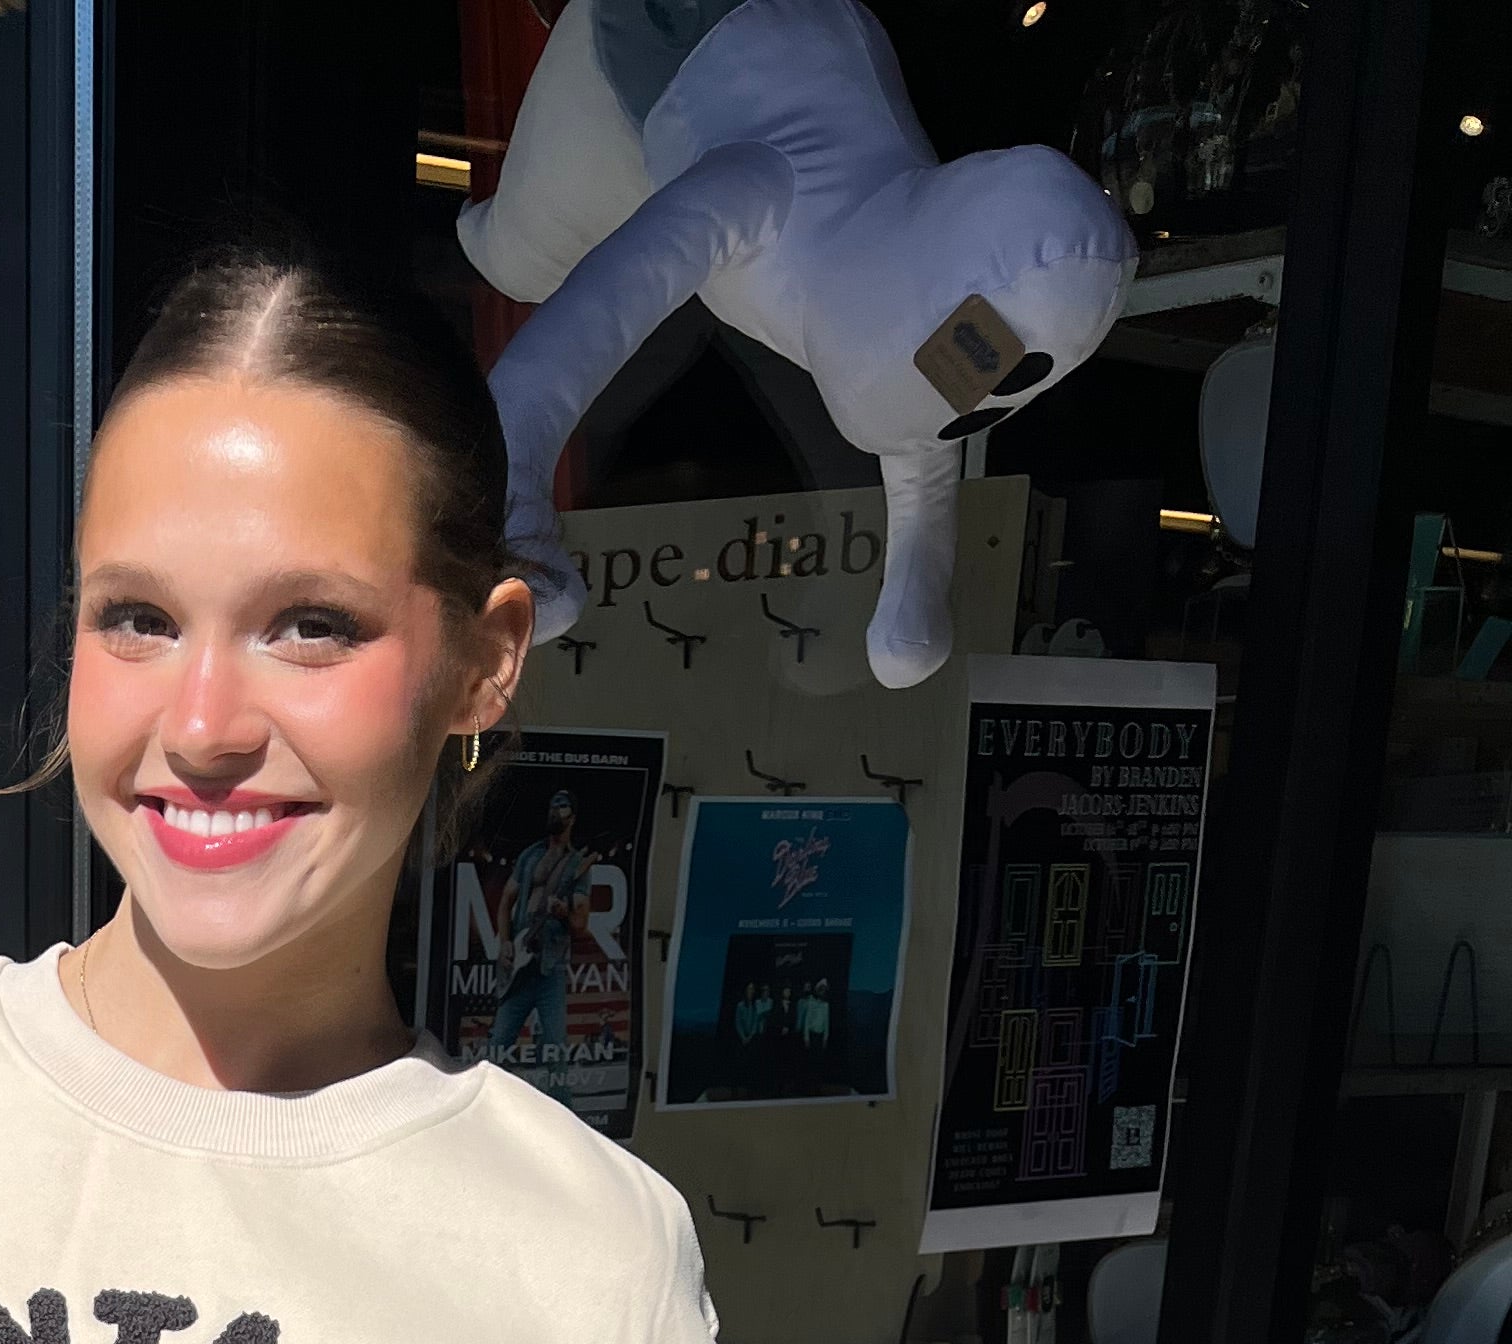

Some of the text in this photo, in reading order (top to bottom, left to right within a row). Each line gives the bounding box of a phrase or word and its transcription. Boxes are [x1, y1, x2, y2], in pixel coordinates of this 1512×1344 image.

[569, 511, 882, 607] ape diab
[977, 718, 1199, 759] EVERYBODY
[538, 751, 564, 763] THE
[590, 754, 629, 766] BARN
[1090, 765, 1203, 788] BY BRANDEN
[451, 962, 629, 996] MIK YAN
[460, 1042, 614, 1064] MIKE RYAN
